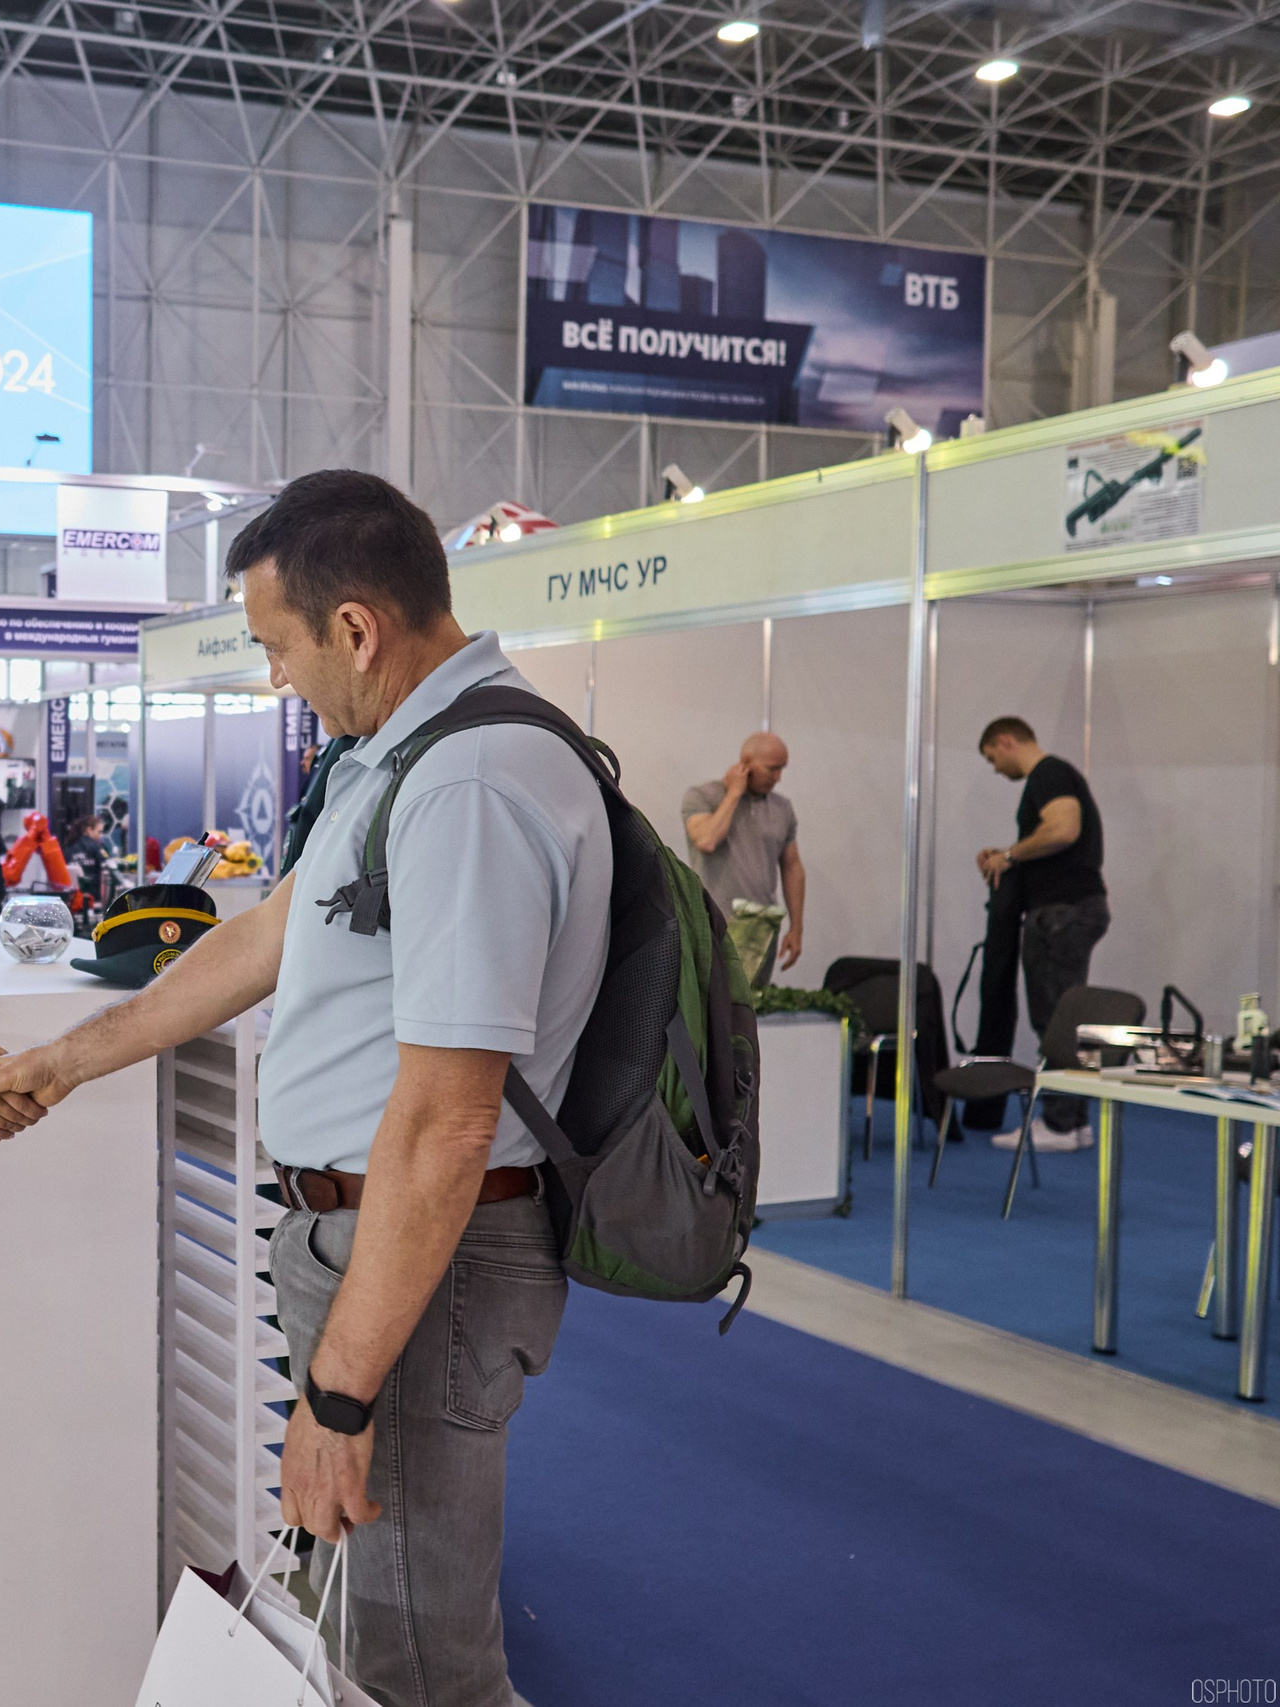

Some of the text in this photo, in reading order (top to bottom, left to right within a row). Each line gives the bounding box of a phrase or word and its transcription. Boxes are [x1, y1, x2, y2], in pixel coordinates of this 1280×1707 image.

[905, 272, 959, 310] ВТБ
[562, 318, 787, 367] ВСЁ ПОЛУЧИТСЯ!
[64, 531, 160, 550] EMERCOM
[548, 555, 667, 602] ГУ МЧС УР
